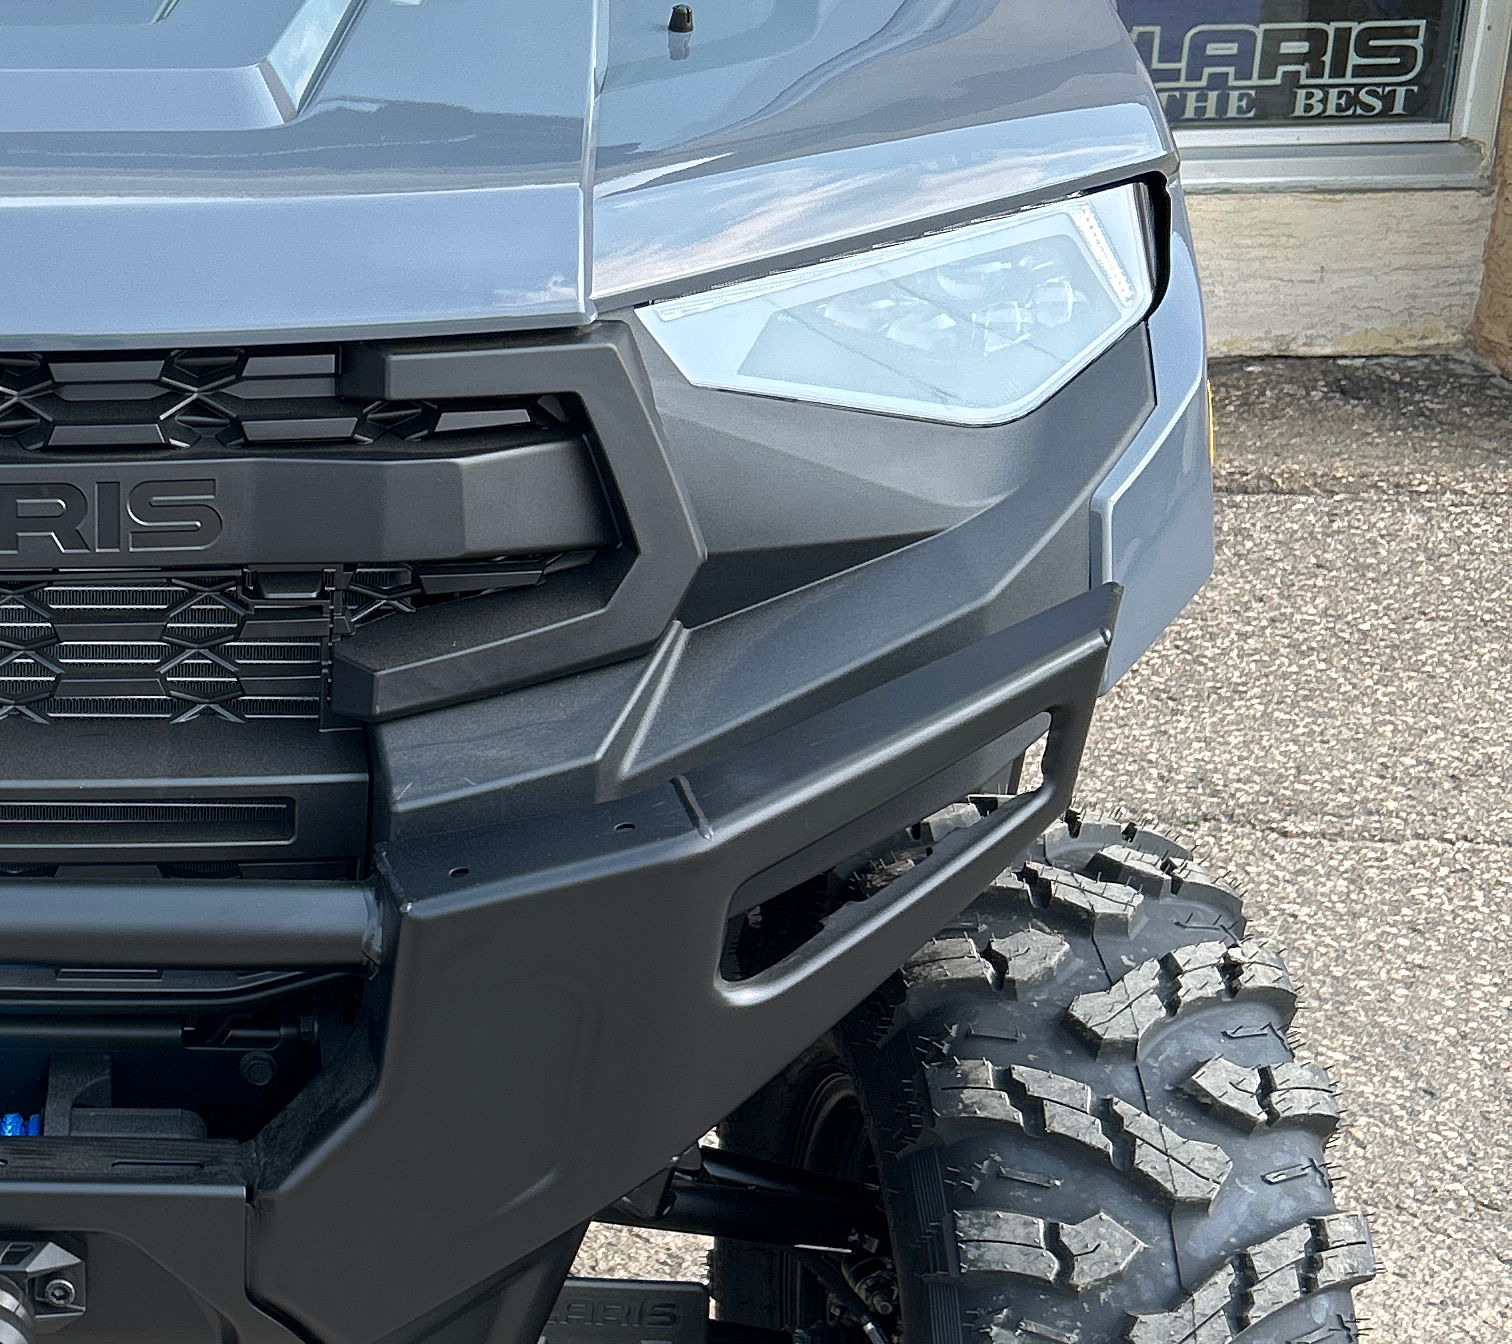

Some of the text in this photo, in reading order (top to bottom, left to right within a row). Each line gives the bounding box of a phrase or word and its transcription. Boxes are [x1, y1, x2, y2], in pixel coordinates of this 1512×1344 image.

[1131, 19, 1427, 87] LARIS
[1290, 85, 1419, 118] BEST
[547, 1298, 678, 1329] ARIS
